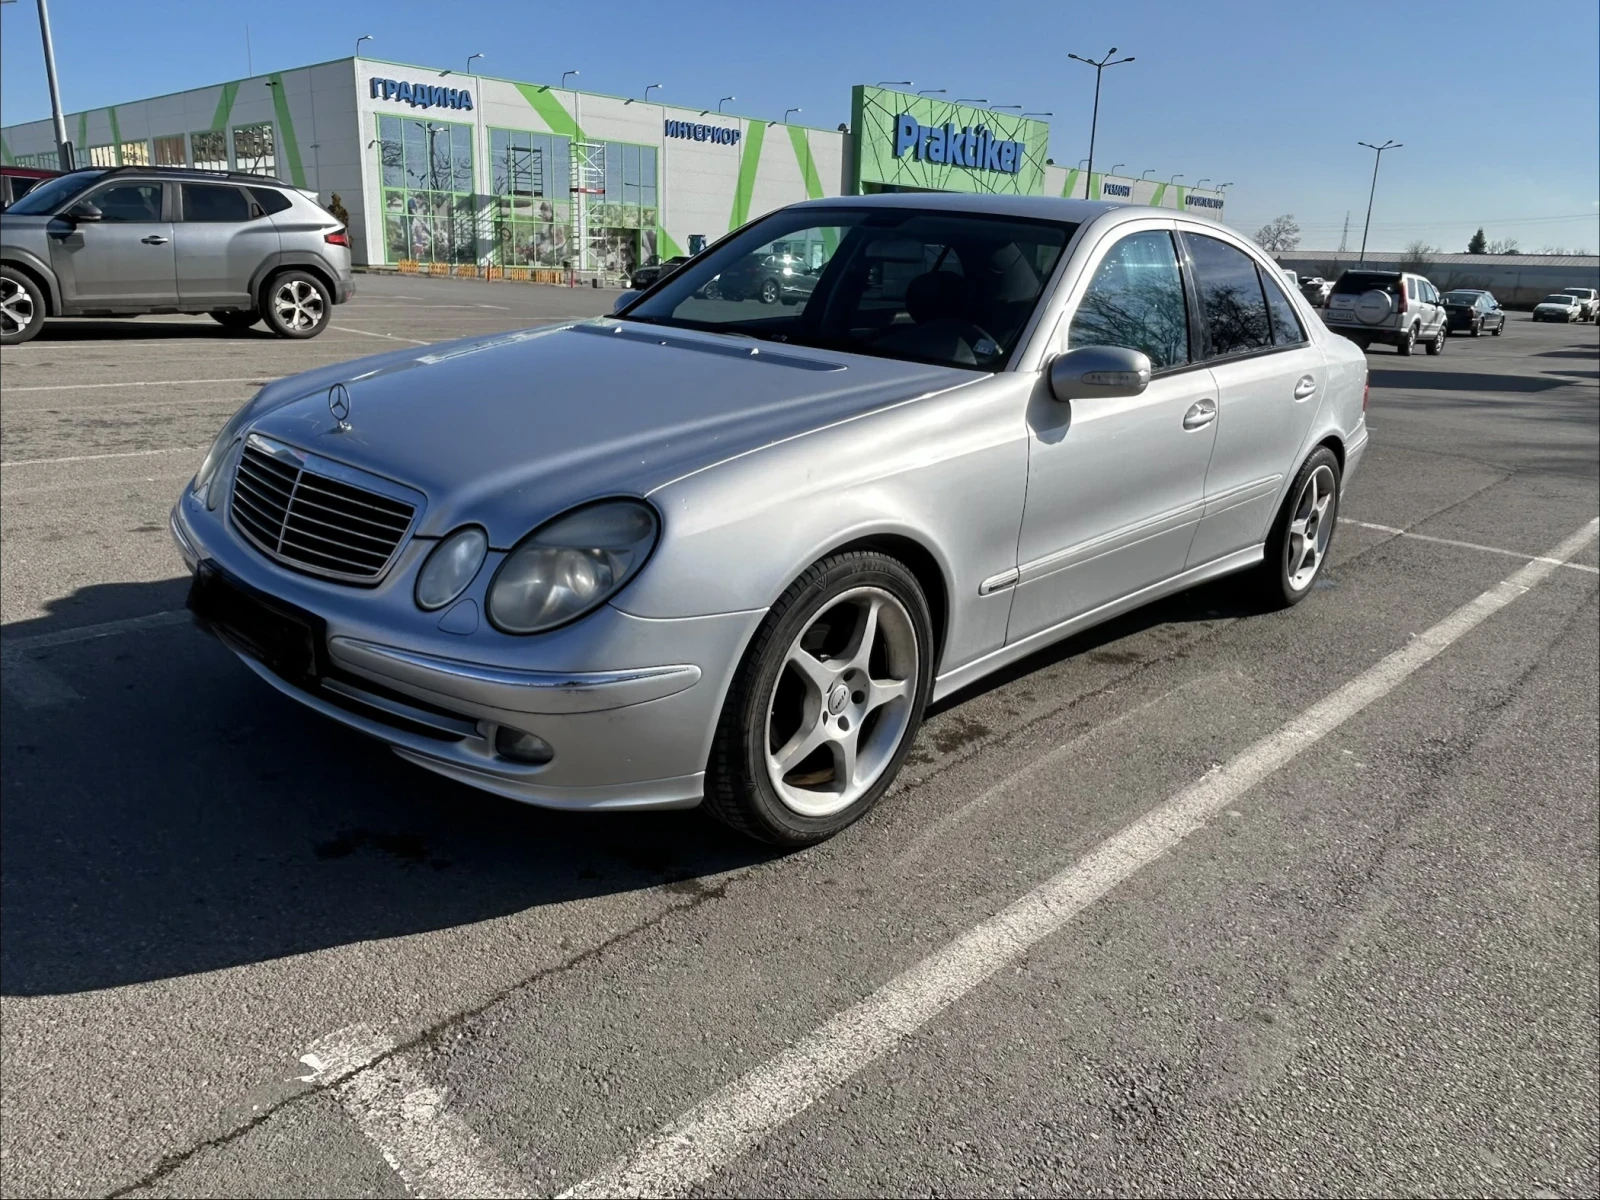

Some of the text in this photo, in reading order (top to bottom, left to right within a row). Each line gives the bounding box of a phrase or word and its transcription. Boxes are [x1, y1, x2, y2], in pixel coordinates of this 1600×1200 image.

[369, 77, 474, 112] ГРАДИНА
[665, 119, 742, 147] ИНТЕРИОР
[892, 113, 1026, 176] Praktiker
